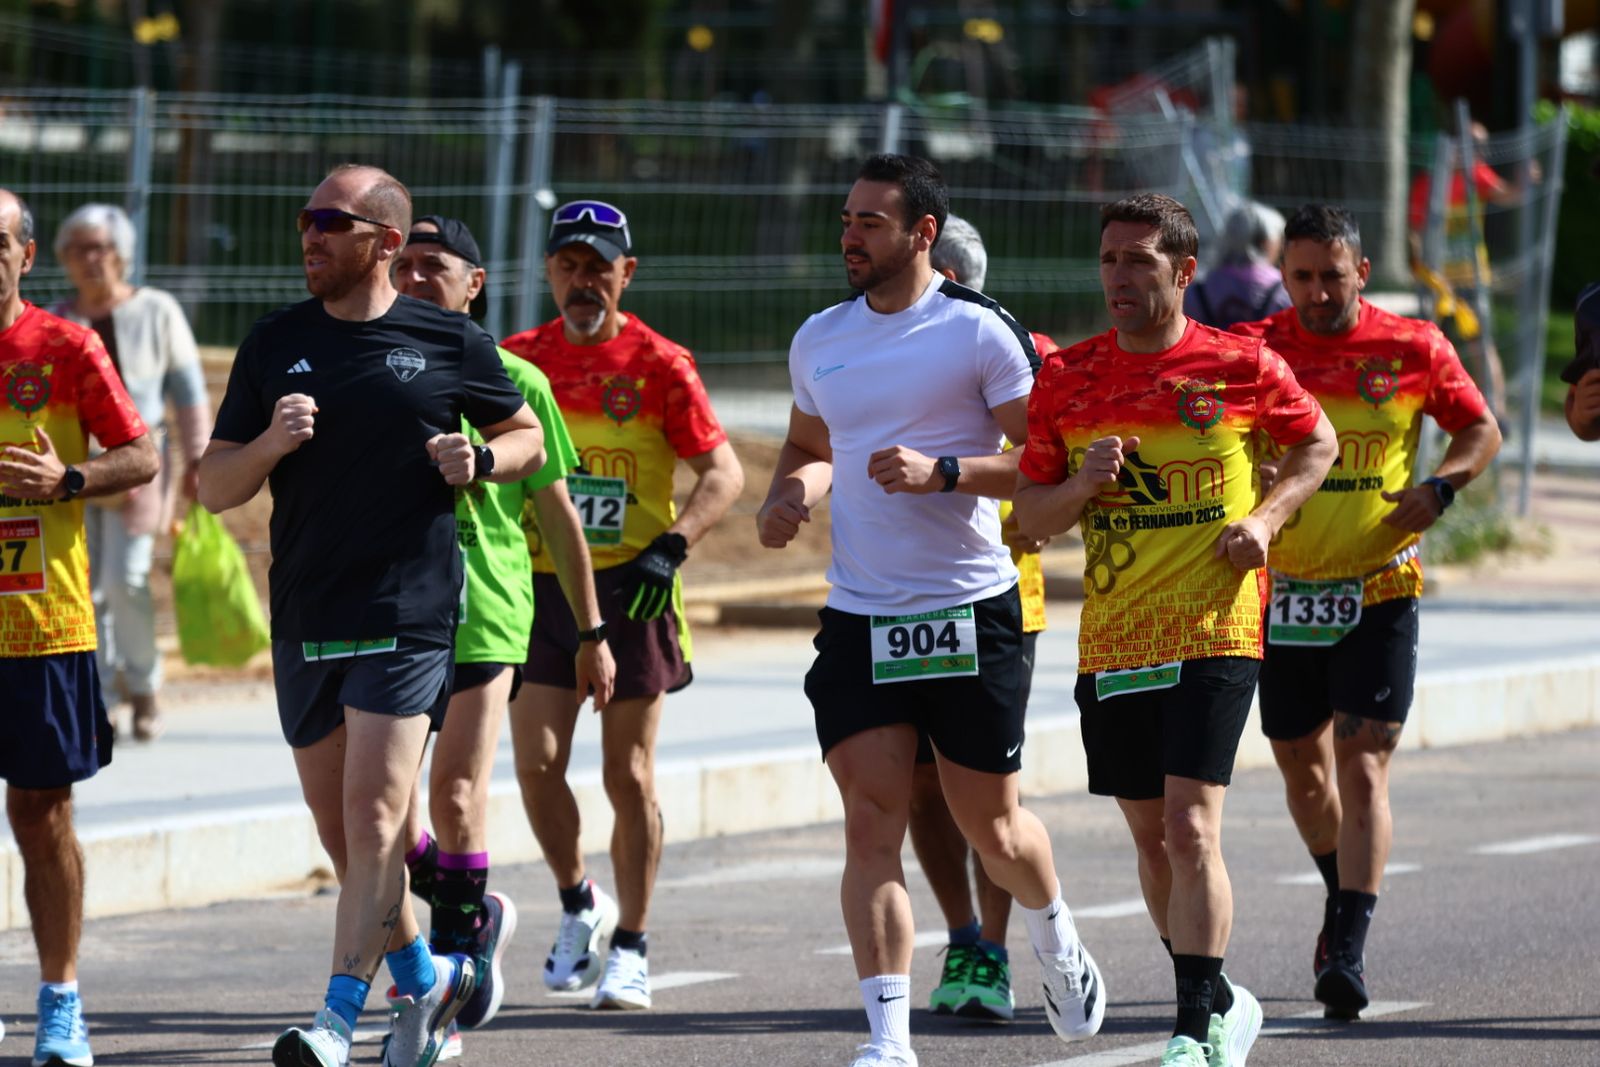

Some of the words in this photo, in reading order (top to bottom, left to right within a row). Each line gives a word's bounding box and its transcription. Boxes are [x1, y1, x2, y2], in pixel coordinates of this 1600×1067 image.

[570, 495, 620, 527] 12
[1093, 514, 1111, 531] SAN
[1130, 510, 1194, 530] FERNANDO
[0, 541, 27, 572] 7
[1276, 595, 1357, 625] 1339
[887, 621, 960, 658] 904
